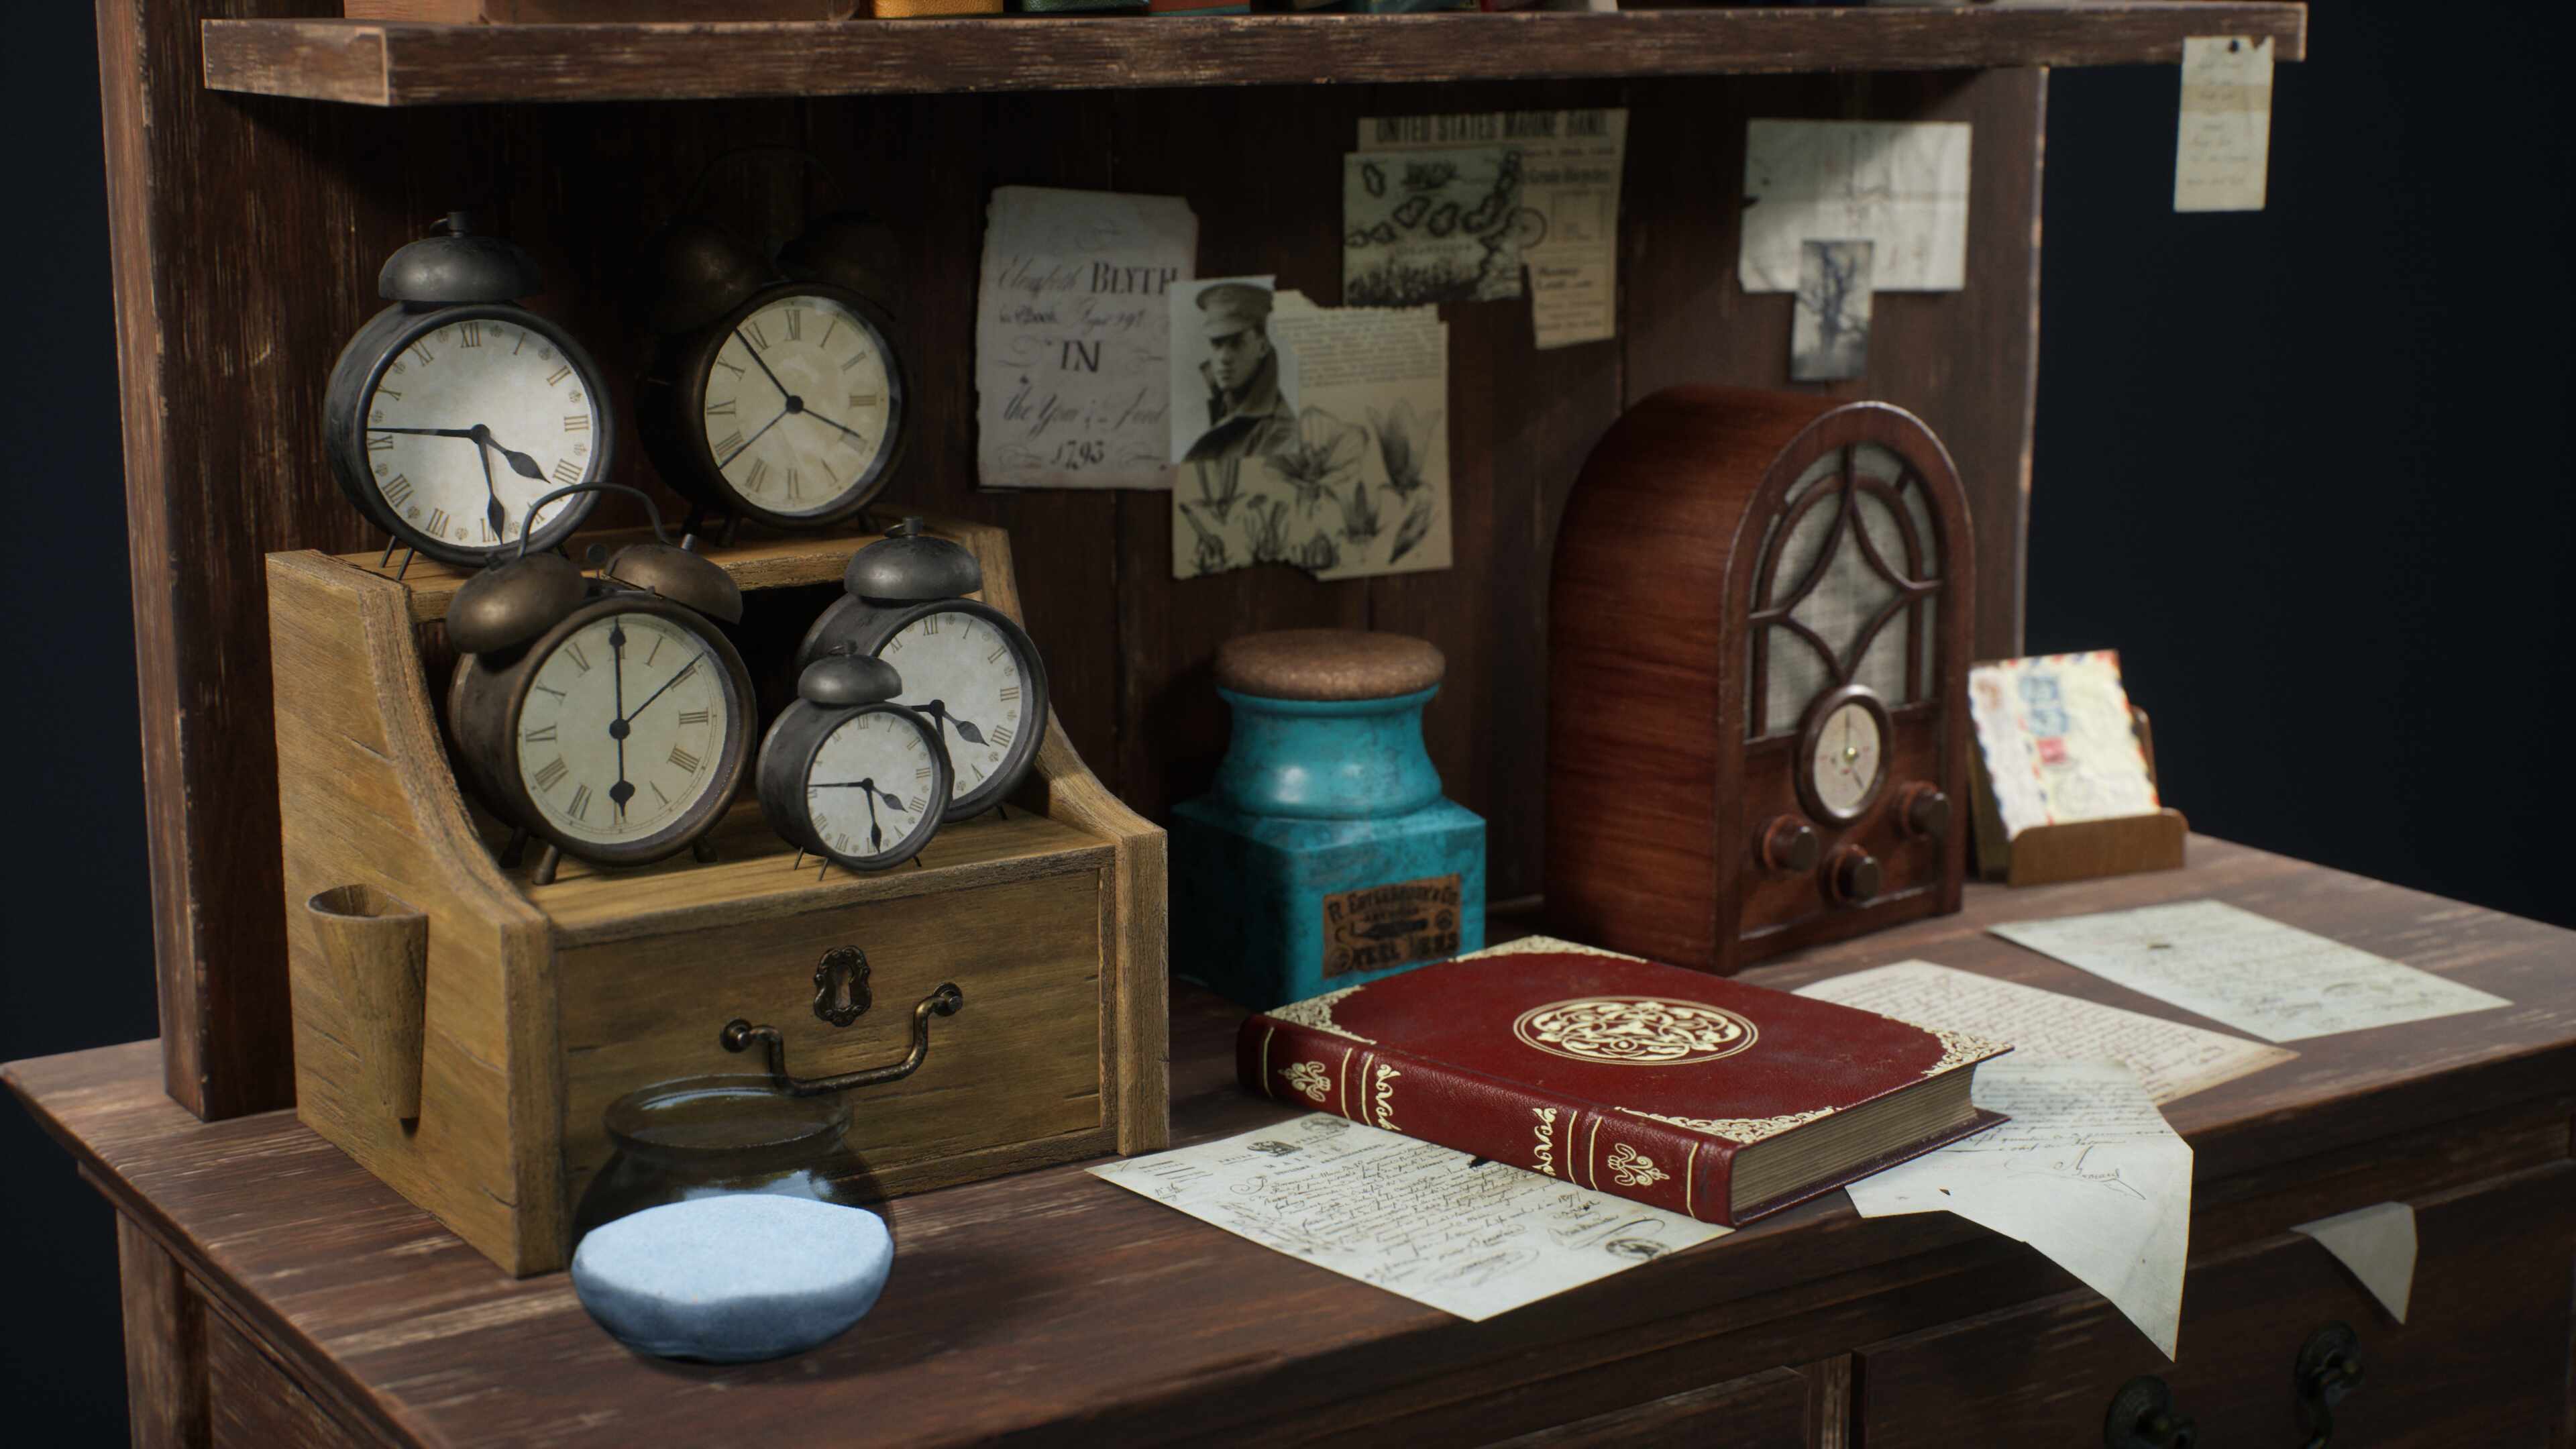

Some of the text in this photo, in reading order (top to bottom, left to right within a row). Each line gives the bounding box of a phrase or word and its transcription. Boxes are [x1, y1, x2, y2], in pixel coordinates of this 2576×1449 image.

[460, 322, 482, 348] XII
[785, 310, 801, 341] XII
[842, 352, 866, 373] II
[1060, 339, 1104, 373] IN
[547, 365, 572, 386] II
[849, 394, 877, 409] III
[564, 414, 590, 433] III
[922, 615, 939, 636] XII
[987, 646, 1008, 665] II
[535, 680, 566, 705] X
[1000, 687, 1020, 702] III
[679, 708, 708, 727] III
[991, 724, 1014, 749] IIII
[667, 746, 701, 775] IIII
[916, 767, 931, 780] III
